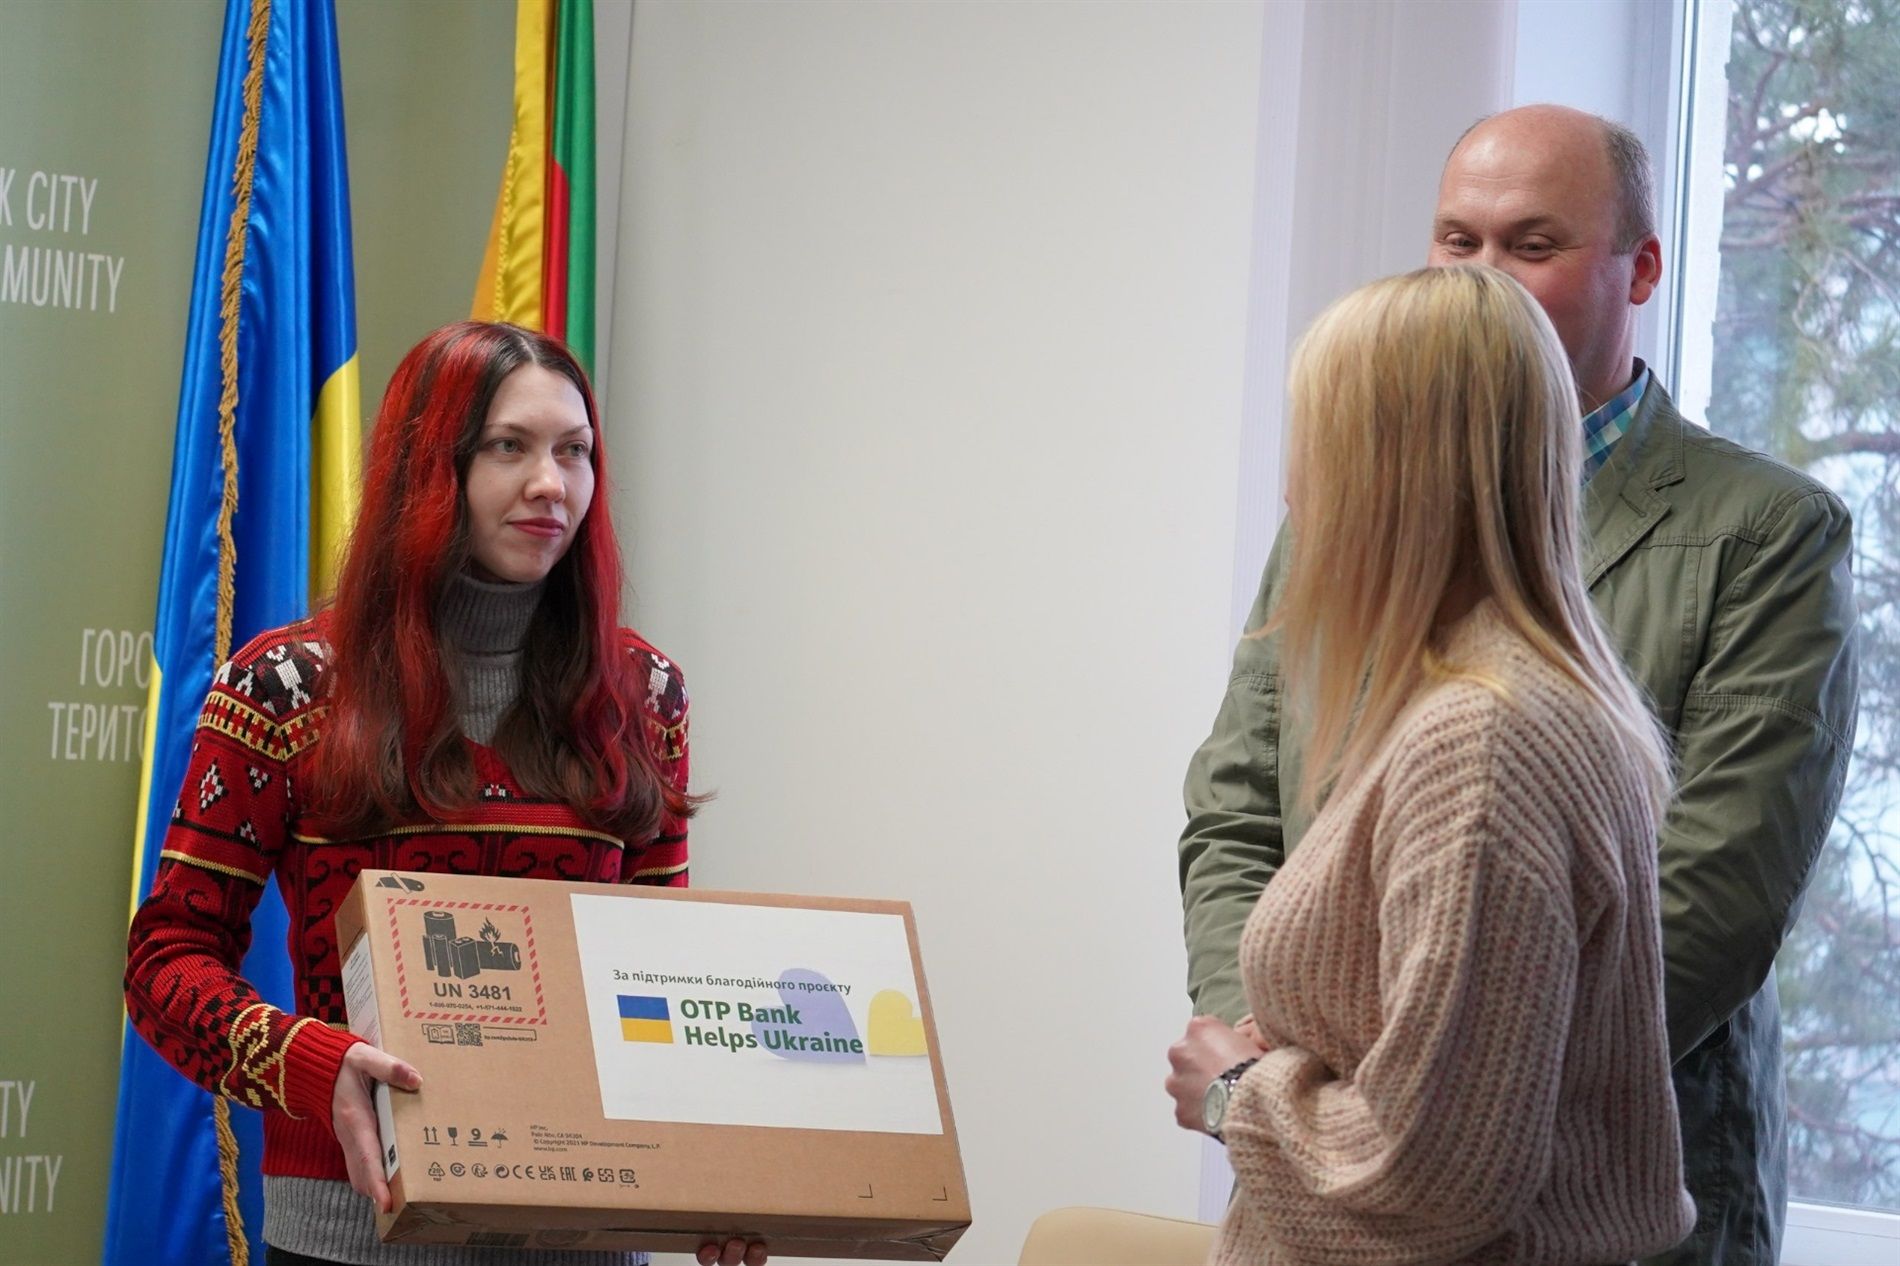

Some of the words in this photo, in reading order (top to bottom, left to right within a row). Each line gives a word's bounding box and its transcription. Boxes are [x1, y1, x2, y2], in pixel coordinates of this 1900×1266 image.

[27, 170, 98, 235] CITY
[1, 244, 124, 313] MUNITY
[80, 628, 154, 689] ГОРО
[433, 982, 463, 998] UN
[468, 984, 511, 1001] 3481
[613, 969, 629, 981] За
[633, 970, 703, 985] підтримки
[706, 975, 795, 990] благодійного
[799, 981, 851, 996] проєкту
[680, 999, 731, 1021] OTP
[737, 1002, 802, 1025] Bank
[684, 1026, 757, 1053] Helps
[764, 1030, 863, 1054] Ukraine
[0, 1080, 36, 1138] TY
